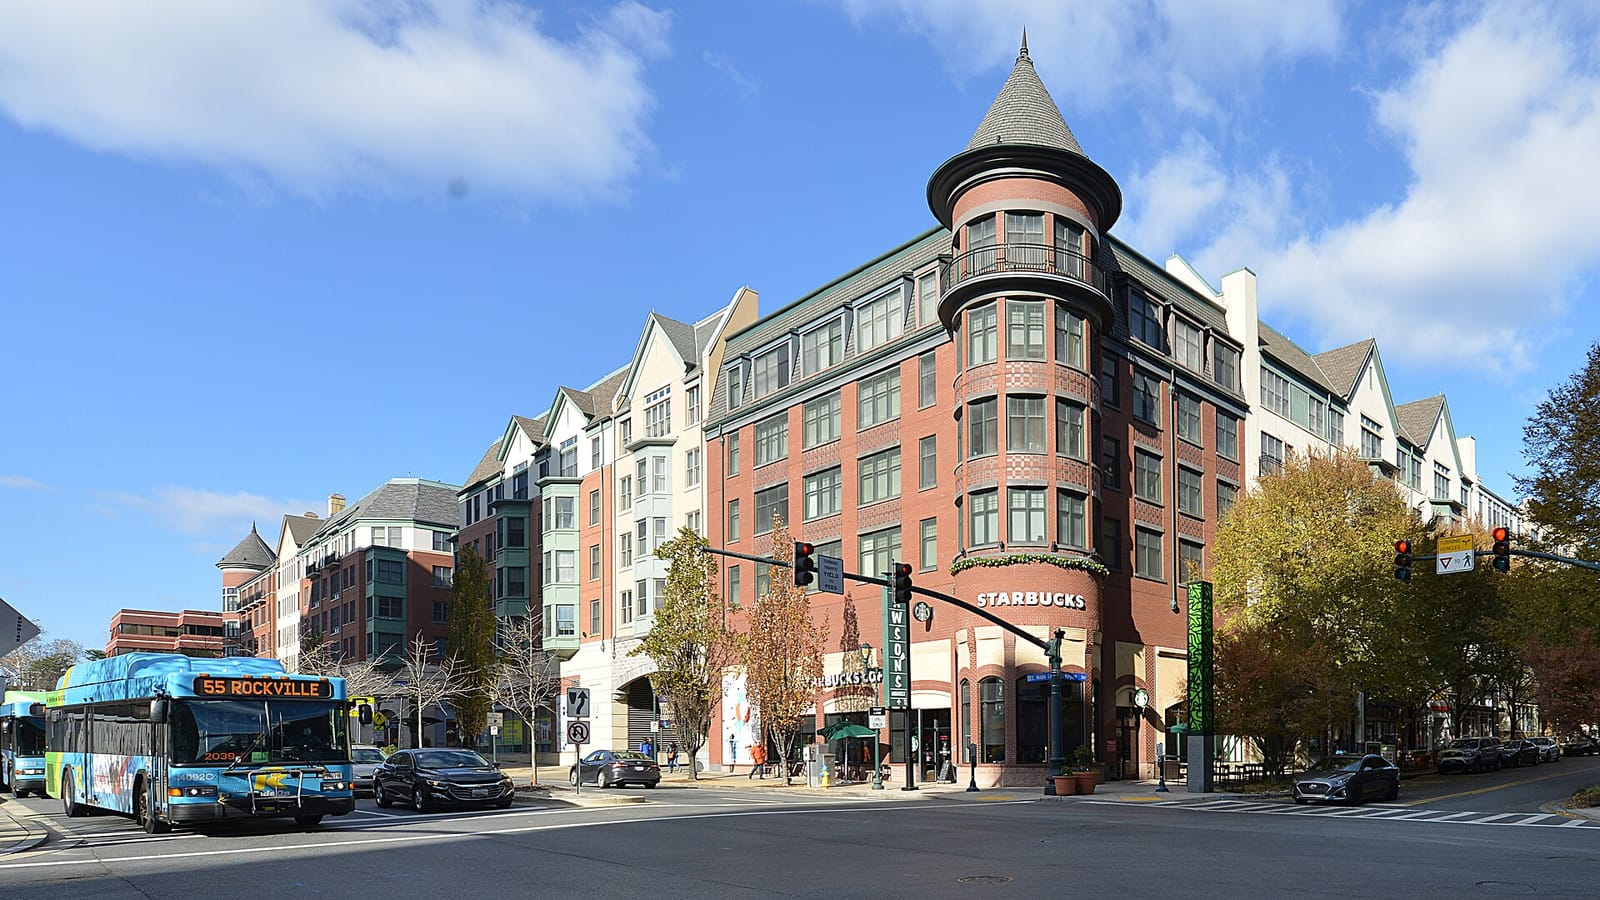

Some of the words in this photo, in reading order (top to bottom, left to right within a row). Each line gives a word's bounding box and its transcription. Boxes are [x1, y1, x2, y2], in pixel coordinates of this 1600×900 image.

[823, 571, 839, 579] YIELD
[977, 591, 1085, 610] STARBUCKS
[203, 680, 225, 694] 55
[231, 680, 320, 696] ROCKVILLE
